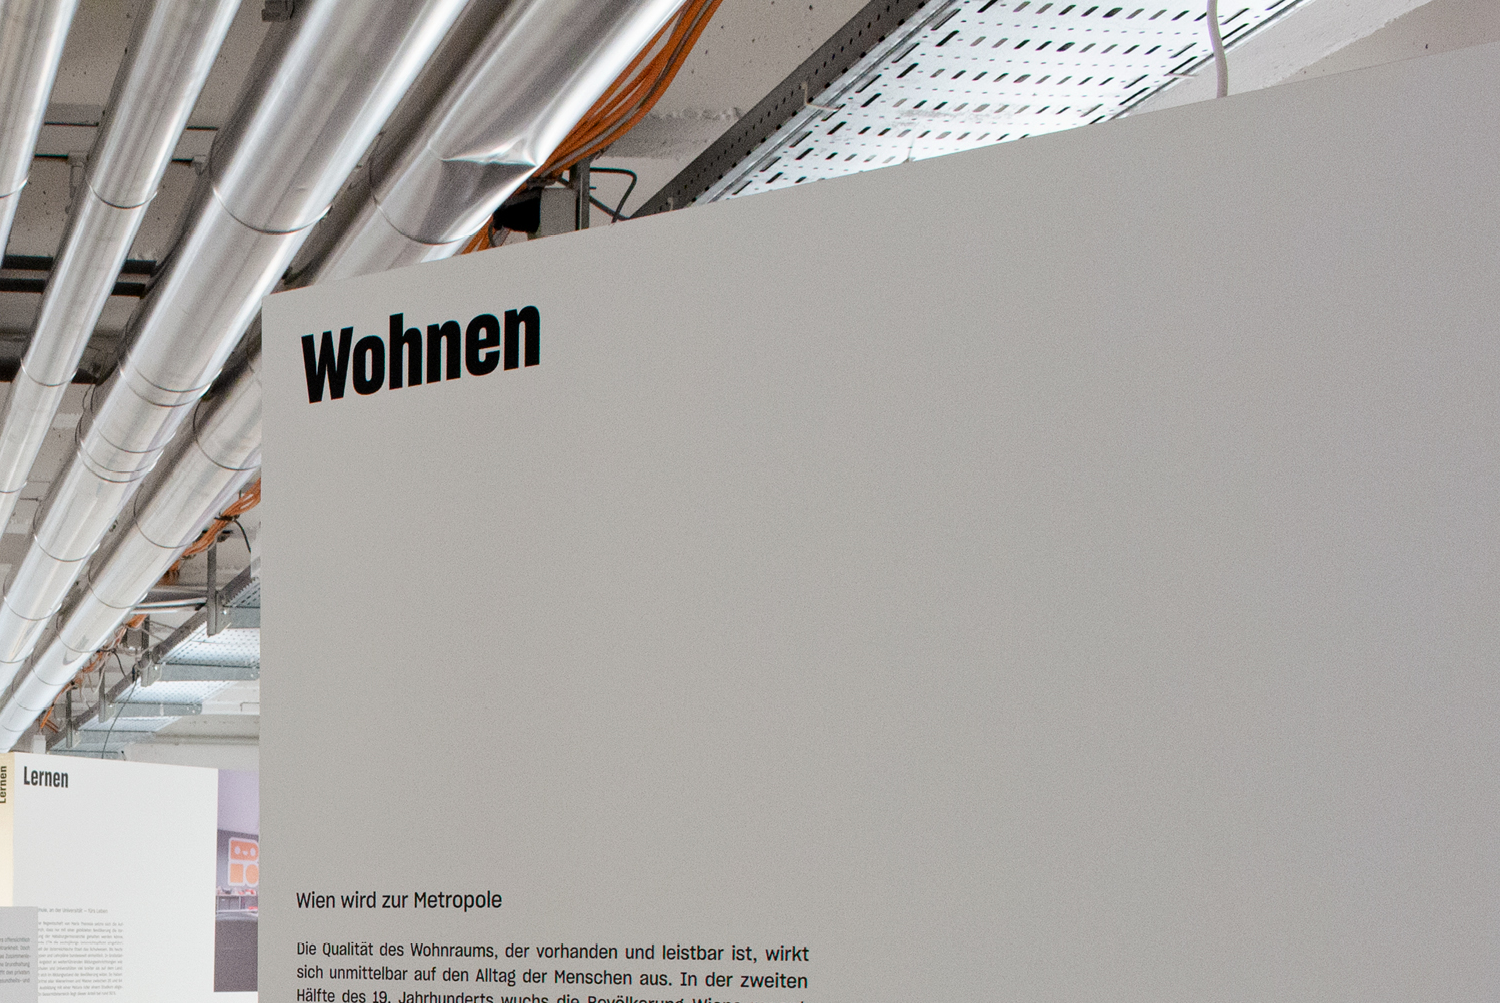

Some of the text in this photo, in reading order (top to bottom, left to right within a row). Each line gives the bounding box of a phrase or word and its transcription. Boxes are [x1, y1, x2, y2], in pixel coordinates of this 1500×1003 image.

[301, 305, 541, 404] Wohnen
[24, 766, 69, 789] Lernen
[296, 890, 502, 912] Wien wird zur Metropole
[296, 940, 810, 964] Die Qualität des Wohnraums, der vorhanden und leistbar ist, wirkt
[296, 964, 808, 989] sich unmittelbar auf den Alltag der Menschen aus. In der zweiten
[296, 987, 335, 1003] Hälfte
[341, 989, 366, 1003] des
[372, 990, 391, 1003] 19.
